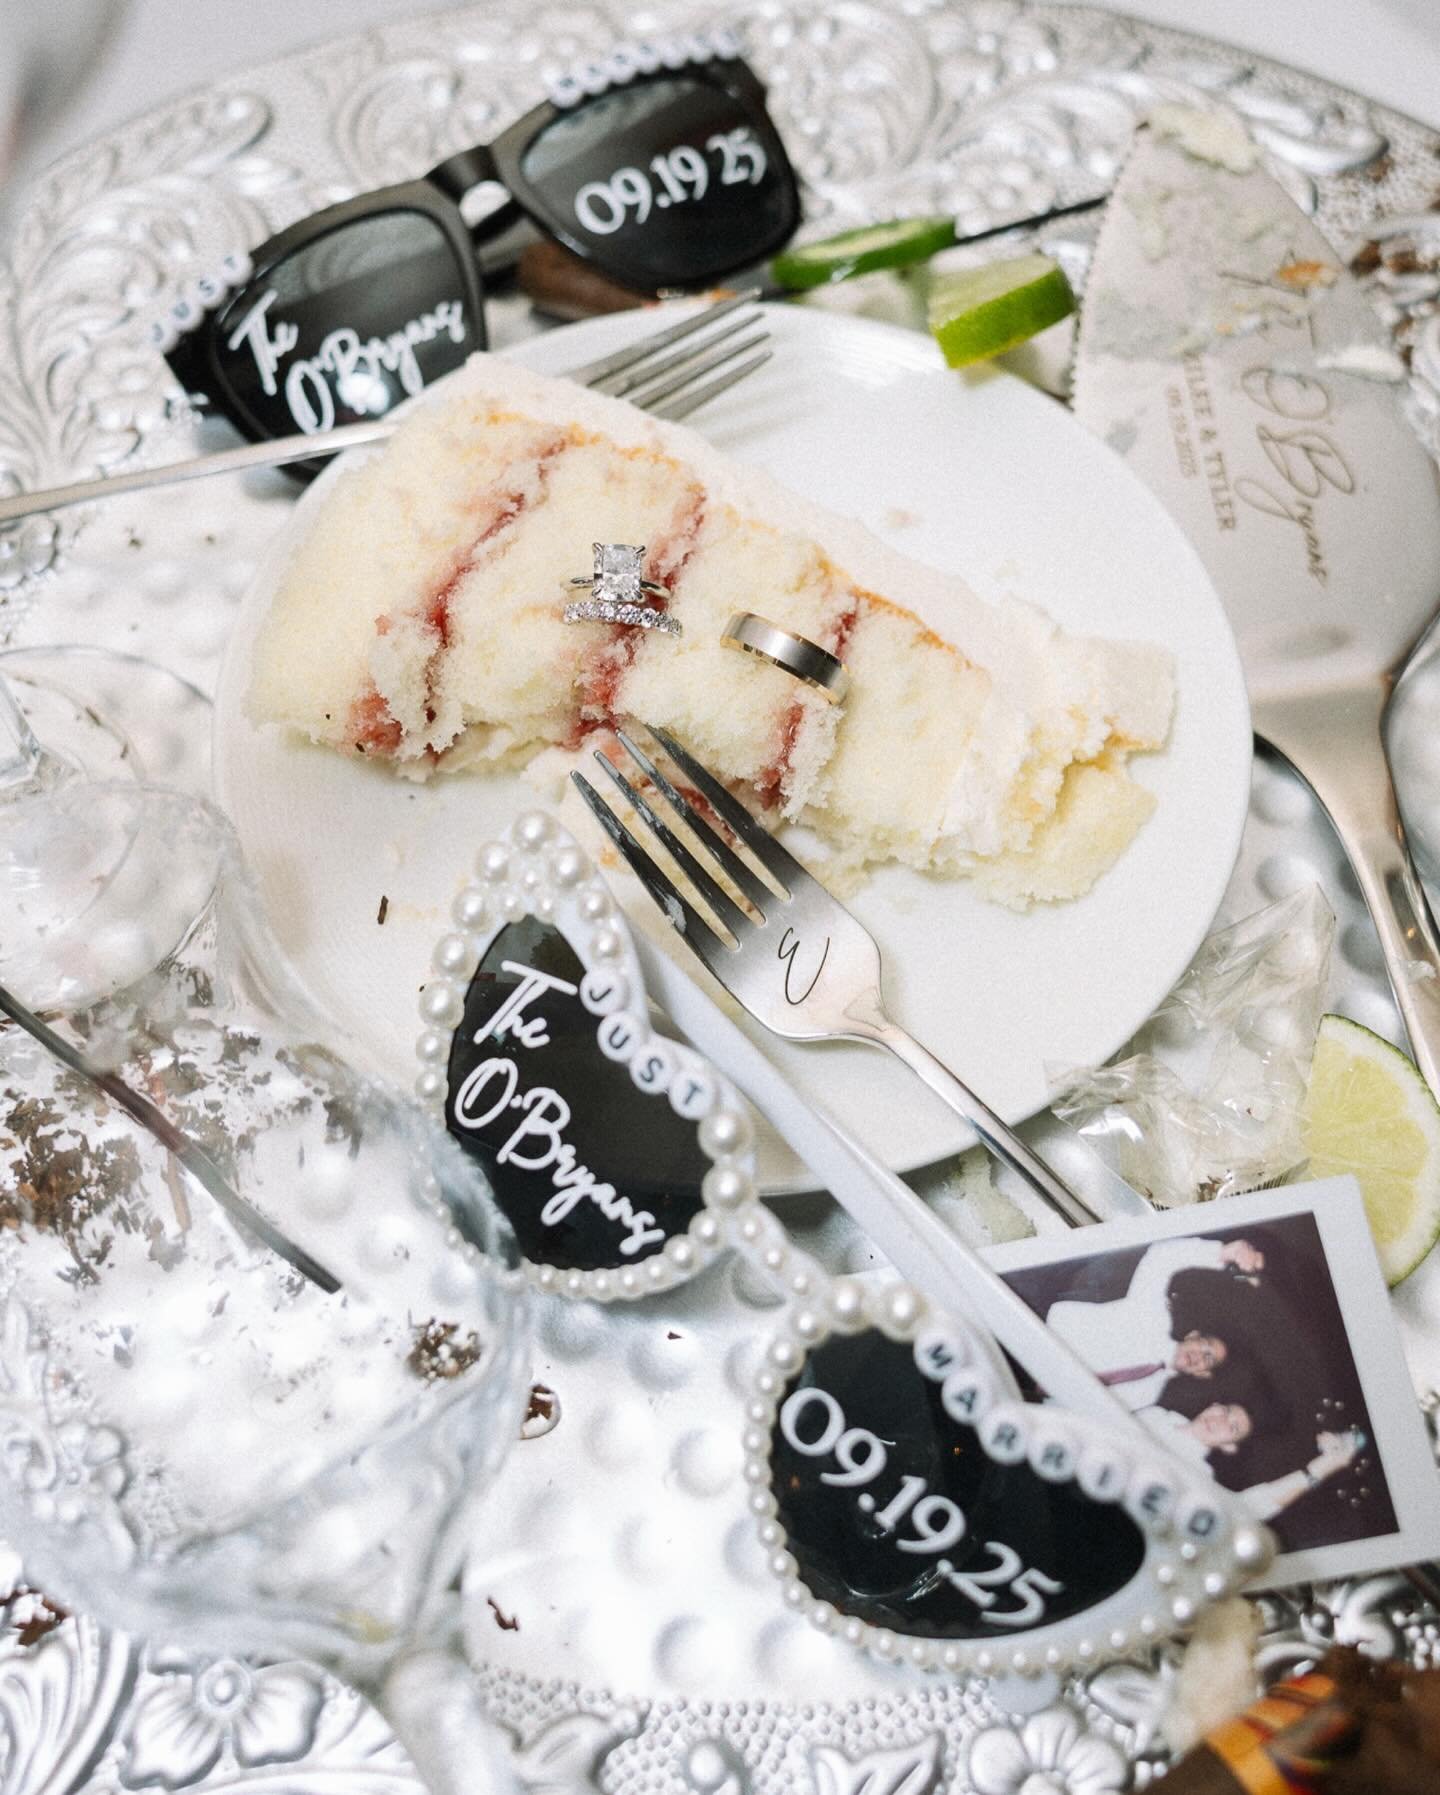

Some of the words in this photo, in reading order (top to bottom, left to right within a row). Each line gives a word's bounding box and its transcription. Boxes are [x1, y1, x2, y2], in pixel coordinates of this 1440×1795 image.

[227, 289, 299, 396] The
[1204, 450, 1237, 531] TYLER
[473, 960, 578, 1048] The
[588, 985, 705, 1107] JUST
[454, 1057, 666, 1256] O'Bryans
[928, 1342, 1217, 1537] MARRIED
[780, 1387, 1065, 1626] 09.19.25
